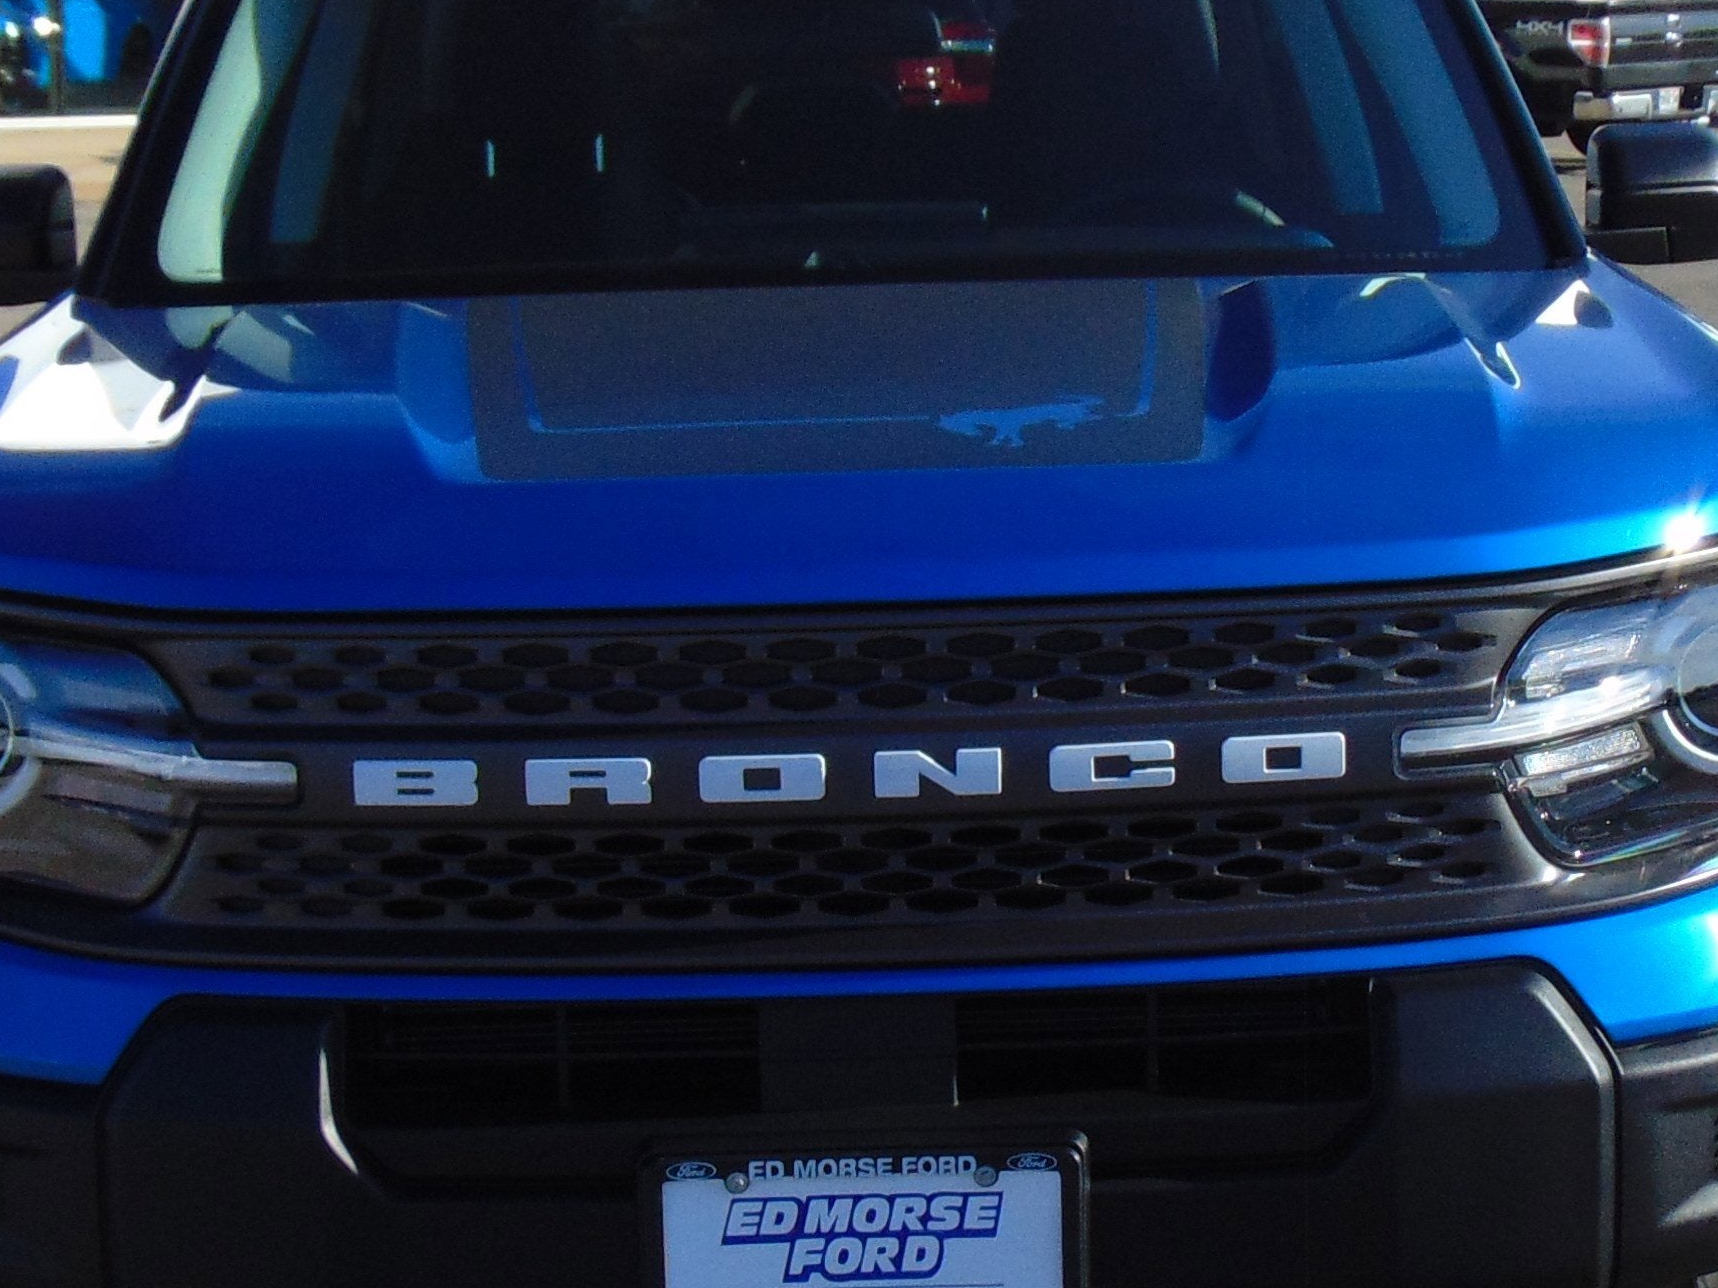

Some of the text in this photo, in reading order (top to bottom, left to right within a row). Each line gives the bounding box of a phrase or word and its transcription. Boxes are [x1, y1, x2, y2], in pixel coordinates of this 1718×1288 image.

[352, 730, 1348, 807] BRONCO
[676, 1164, 707, 1179] Ford
[748, 1154, 978, 1181] ED MORSE FORD
[1016, 1154, 1046, 1169] Ford
[725, 1194, 1000, 1237] ED MORSE
[788, 1235, 940, 1276] FORD
